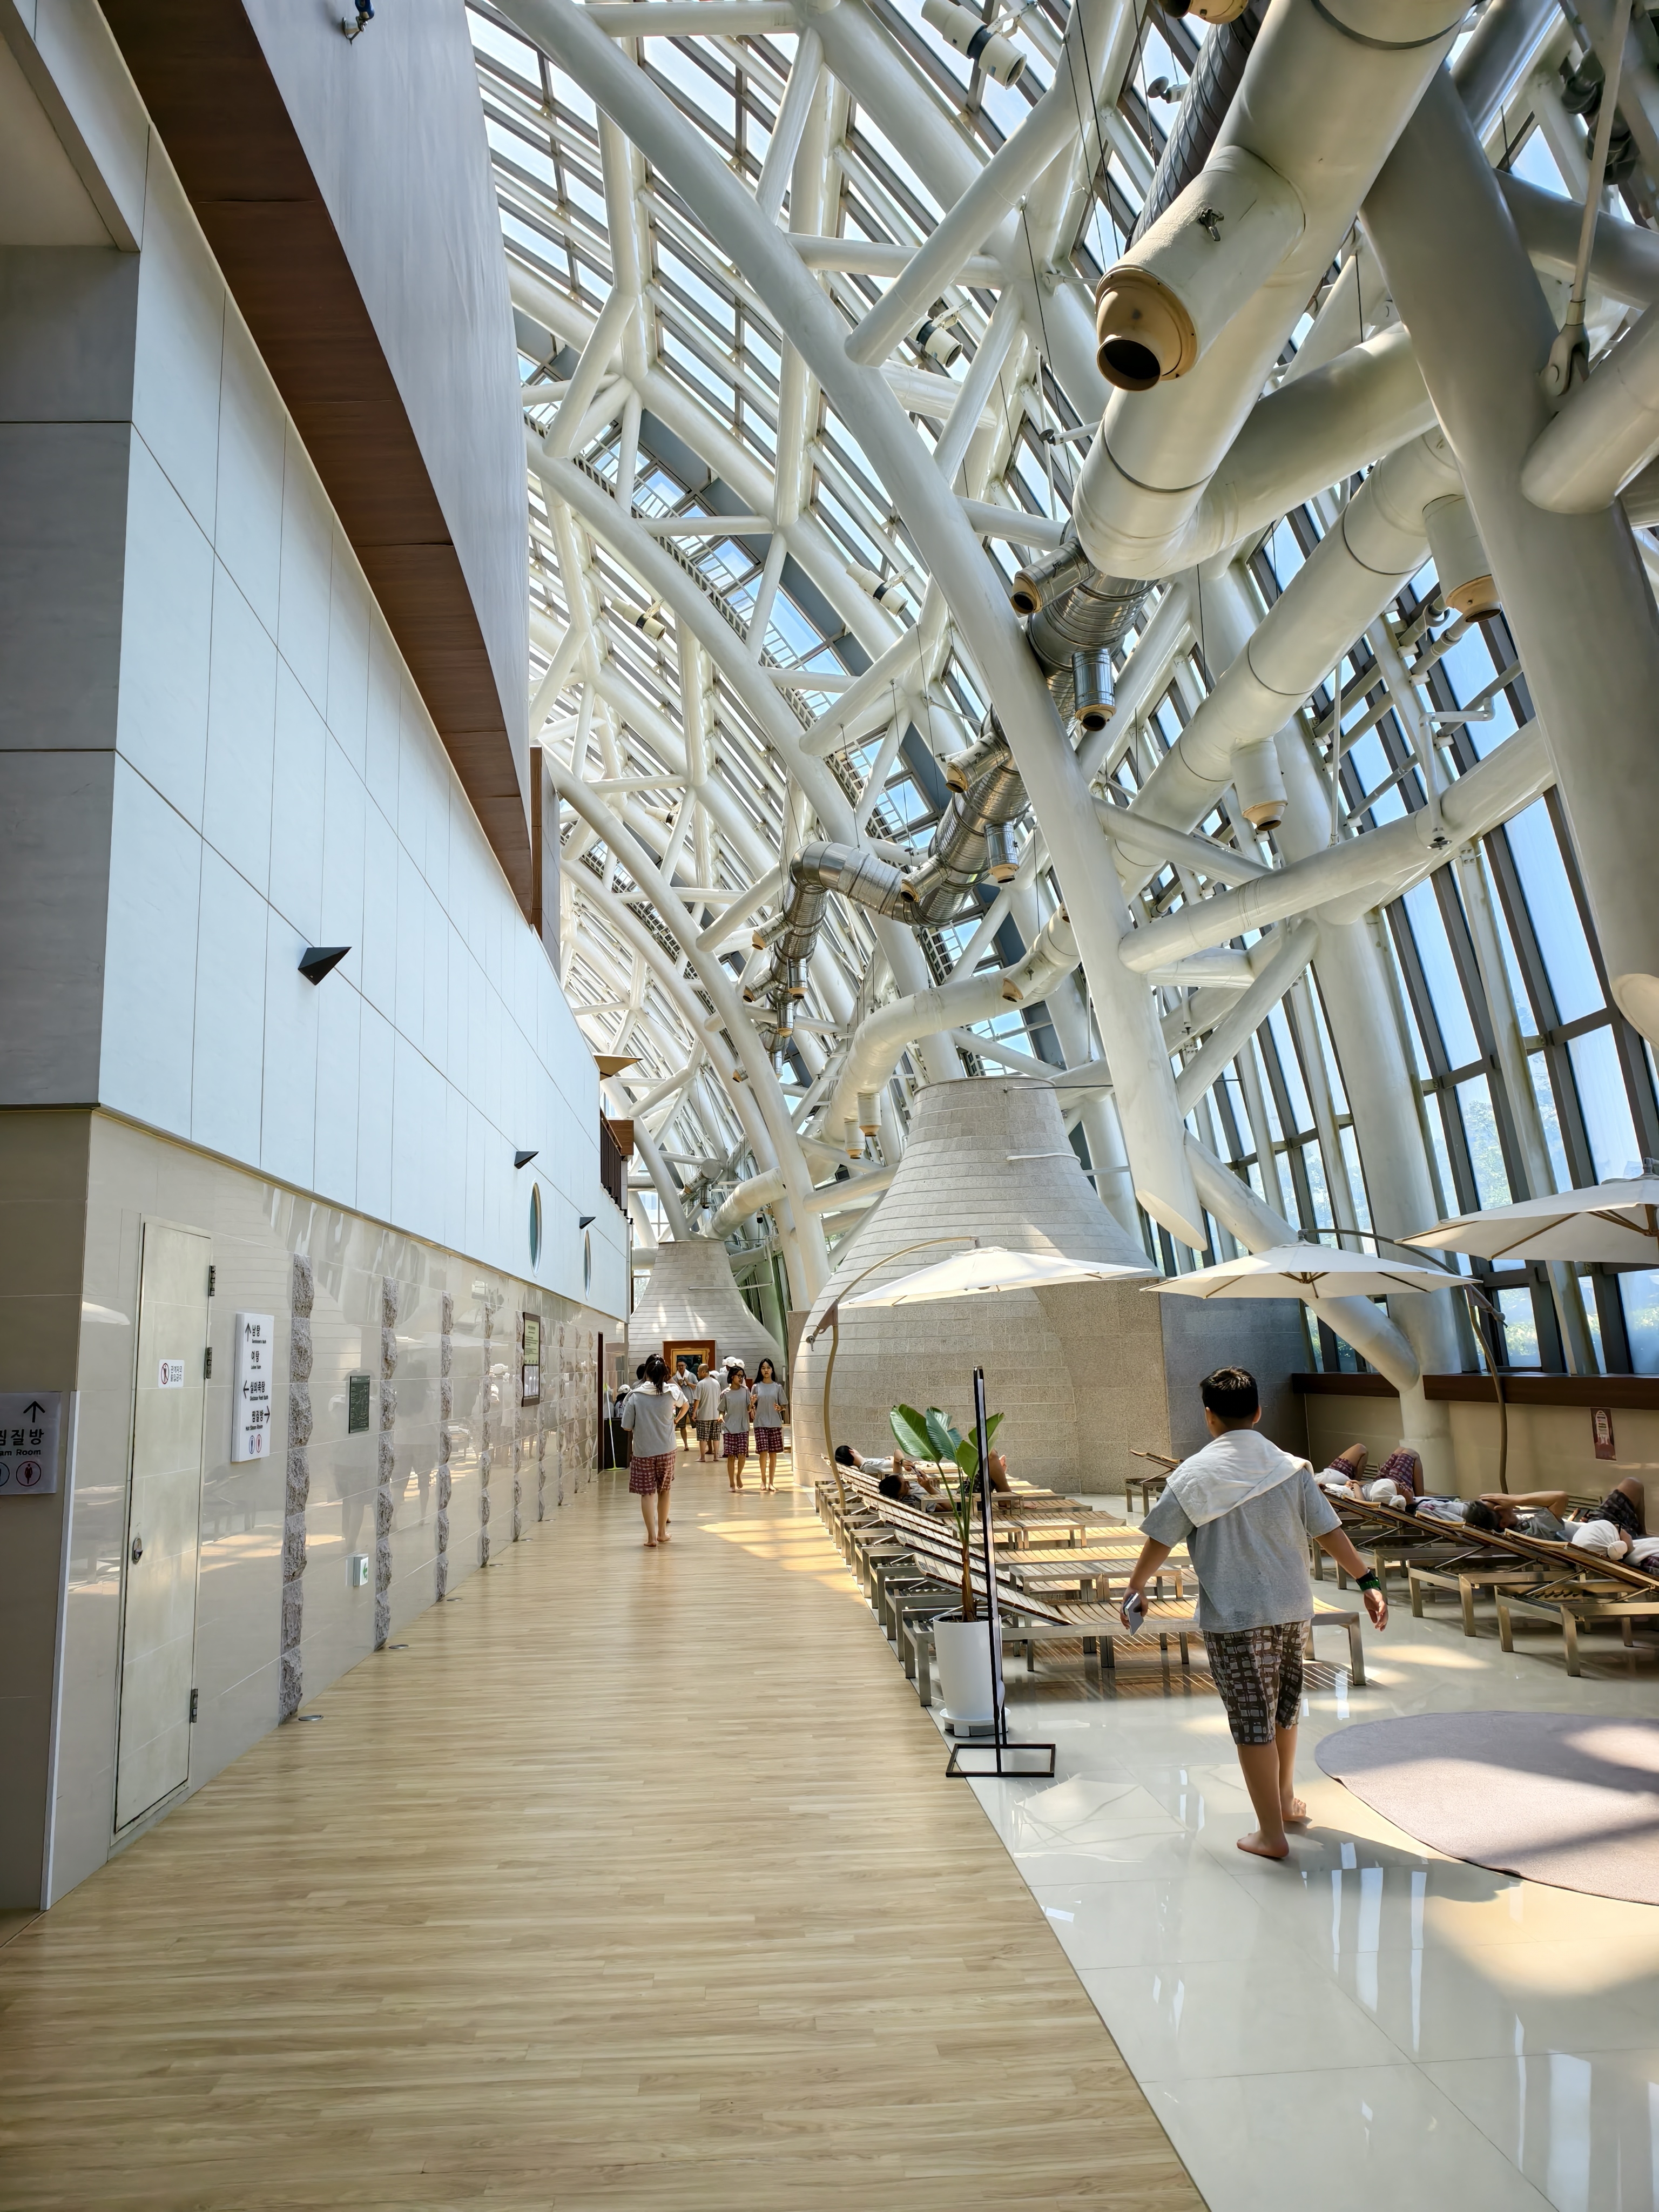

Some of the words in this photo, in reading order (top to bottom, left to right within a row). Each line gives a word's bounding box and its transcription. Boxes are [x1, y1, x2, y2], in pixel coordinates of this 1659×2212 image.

[252, 1325, 261, 1337] 남탕
[251, 1350, 260, 1363] 여탕
[250, 1381, 265, 1393] 실외족탕
[252, 1410, 264, 1422] 찜질방
